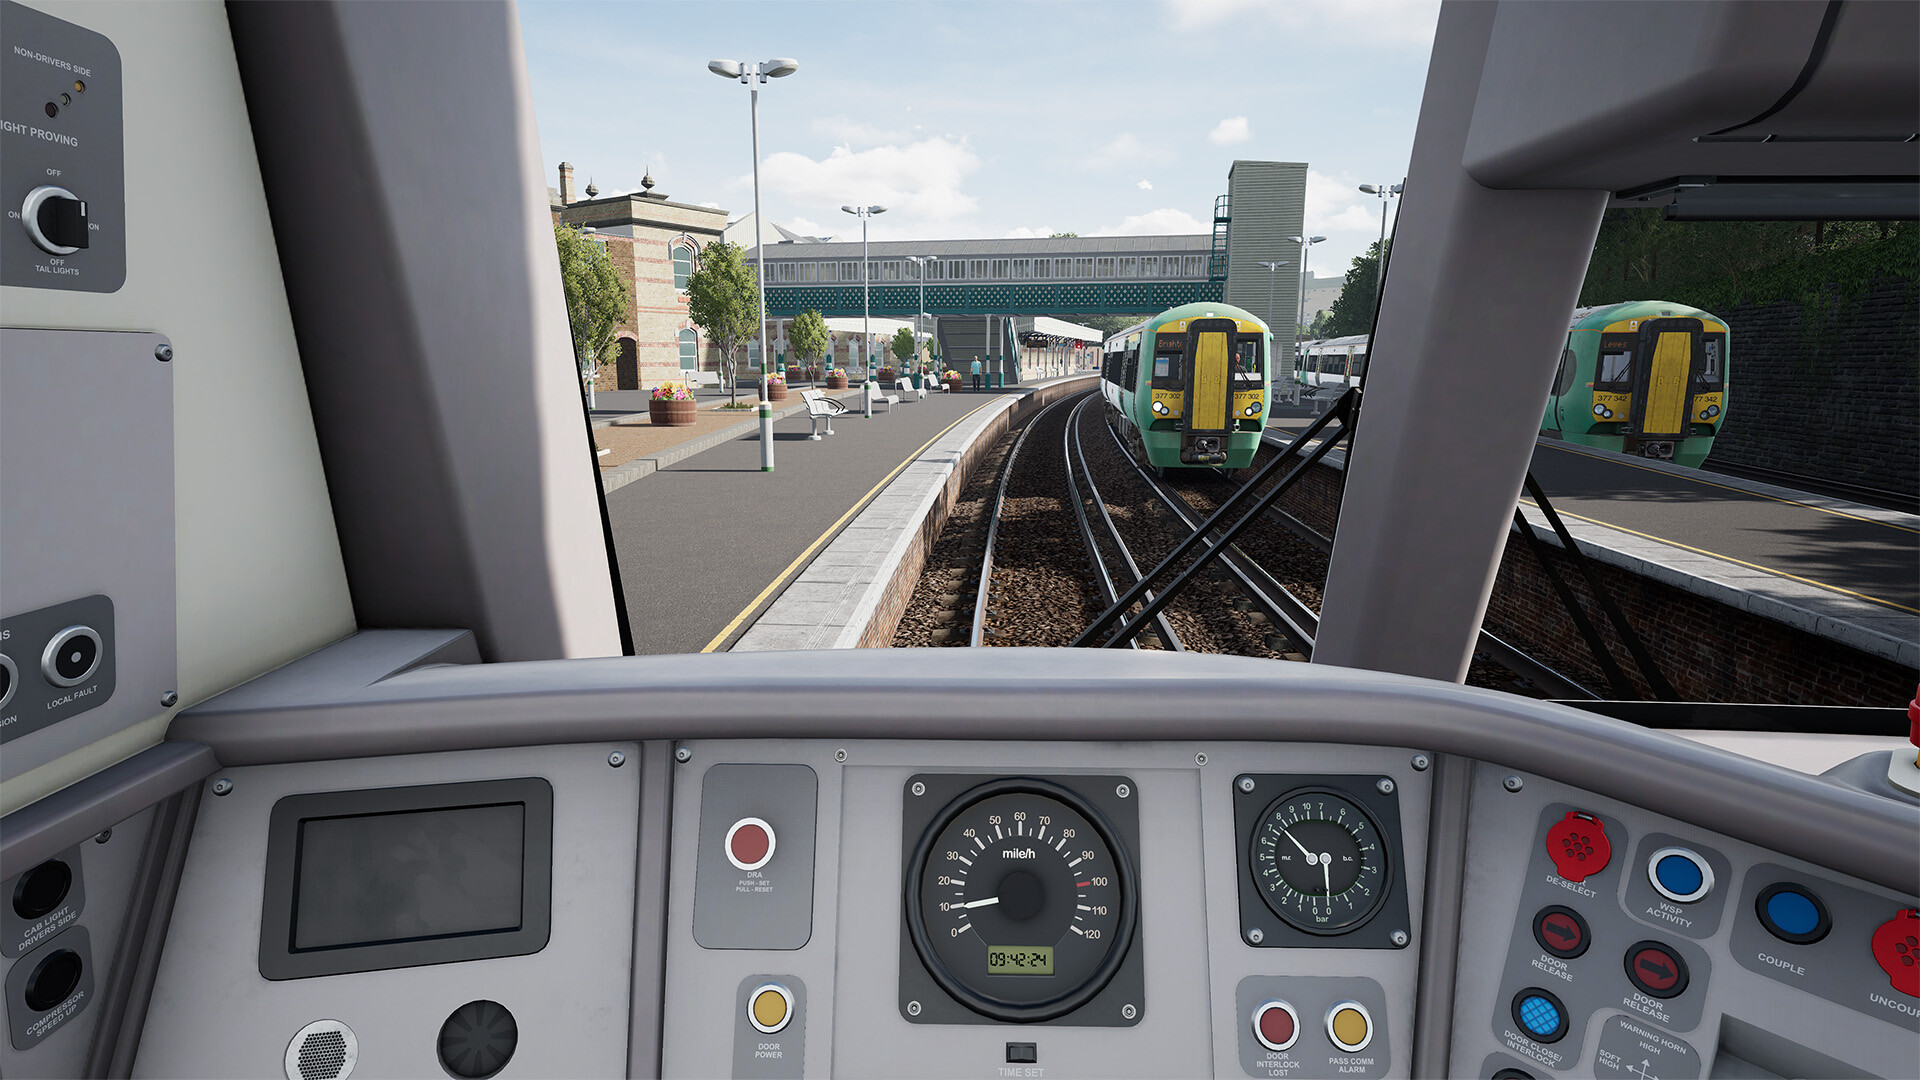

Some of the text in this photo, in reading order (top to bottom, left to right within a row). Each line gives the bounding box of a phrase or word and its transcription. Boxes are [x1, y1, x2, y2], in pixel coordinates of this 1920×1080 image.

[14, 46, 91, 77] NON-DRIVERS SIDE
[0, 120, 78, 147] IGHT PROVING
[46, 168, 61, 177] OFF
[8, 210, 20, 219] ON
[89, 223, 100, 231] ON
[50, 258, 65, 266] OFF
[35, 265, 79, 276] TAIL LIGHTS
[47, 684, 98, 710] LOCAL FAULT
[1289, 805, 1295, 813] 9
[1302, 802, 1311, 810] 10
[1318, 802, 1324, 810] 7
[1013, 811, 1026, 821] 60
[1276, 812, 1282, 820] 8
[1340, 808, 1346, 816] 6
[989, 815, 1002, 825] 50
[1038, 815, 1051, 826] 70
[1358, 821, 1364, 830] 5
[963, 828, 976, 838] 40
[1063, 828, 1075, 838] 80
[1261, 837, 1267, 845] 6
[1369, 843, 1375, 851] 4
[946, 851, 959, 861] 30
[1002, 847, 1036, 860] mile/h
[1082, 851, 1094, 861] 90
[1259, 853, 1265, 861] 5
[1262, 869, 1269, 877] 4
[1371, 866, 1377, 874] 3
[938, 876, 950, 886] 20
[1091, 877, 1108, 887] 100
[1269, 884, 1276, 892] 3
[1546, 875, 1597, 898] DE-SELECT
[1364, 888, 1370, 896] 2
[1281, 897, 1288, 905] 2
[1348, 902, 1353, 910] 1
[939, 902, 950, 912] 10
[1092, 906, 1108, 916] 110
[1297, 904, 1302, 912] 1
[1312, 907, 1318, 915] 0
[1326, 907, 1332, 915] 0
[1659, 902, 1683, 916] WSP
[23, 906, 70, 938] CAB LIGHT
[1315, 915, 1330, 923] bar
[1646, 906, 1692, 929] ACTIVITY
[18, 910, 78, 952] DRIVERS SIDE
[951, 928, 958, 938] 0
[1084, 929, 1101, 940] 120
[989, 952, 1047, 967] 09:42:24
[1541, 954, 1568, 971] DOOR
[1757, 952, 1806, 976] COUPLE
[1531, 959, 1574, 983] RELEASE
[1633, 992, 1664, 1012] DOOR
[26, 990, 85, 1036] COMPRESSOR
[1622, 997, 1671, 1024] RELEASE
[36, 1004, 78, 1038] SPEED UP
[1620, 1020, 1687, 1055] WARNING HORN
[758, 1043, 780, 1051] DOOR
[1504, 1029, 1563, 1062] DOOR CLOSE/
[1639, 1041, 1661, 1055] HIGH
[755, 1051, 783, 1059] POWER
[1506, 1039, 1556, 1068] INTERLOCK
[1599, 1049, 1622, 1063] SOFT
[1256, 1061, 1300, 1069] INTERLOCK
[1328, 1057, 1375, 1066] PASS COMM
[1598, 1056, 1620, 1071] HIGH
[998, 1068, 1045, 1078] TIME SET
[1268, 1069, 1289, 1077] LOST
[1338, 1066, 1366, 1074] ALARM
